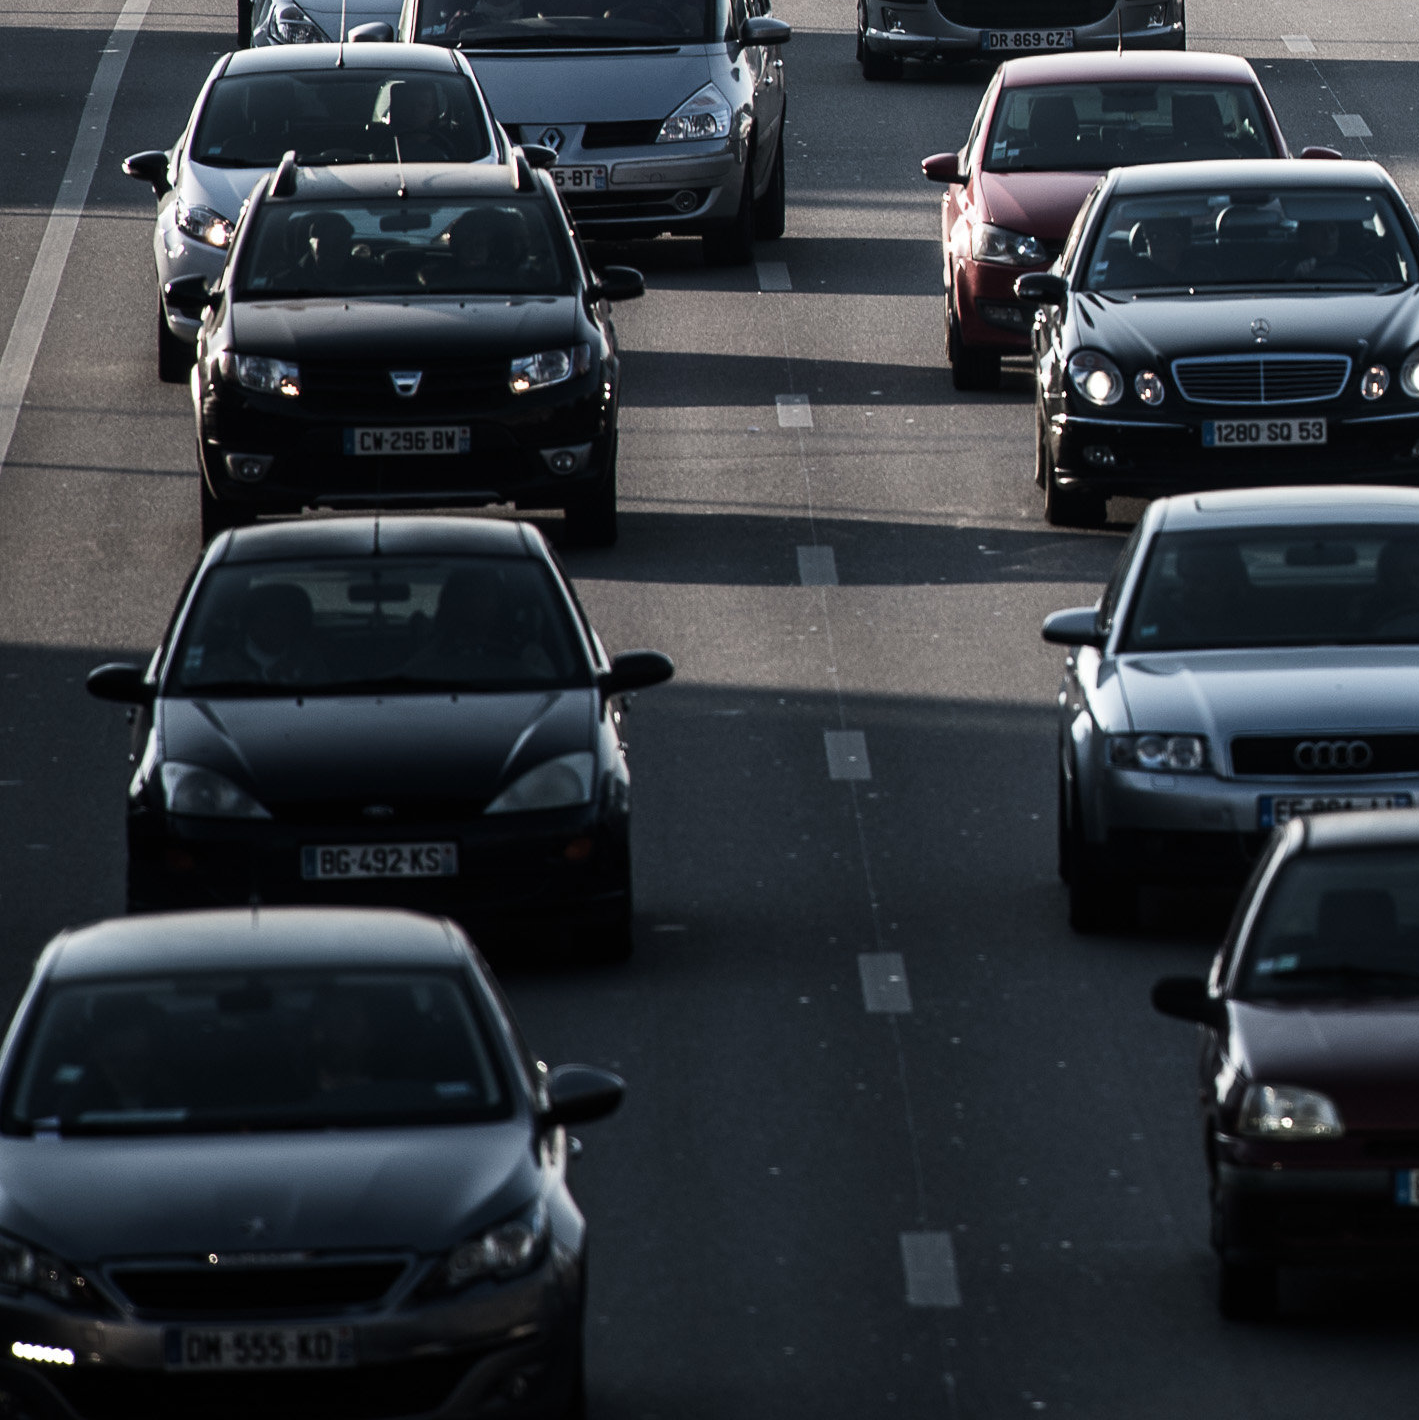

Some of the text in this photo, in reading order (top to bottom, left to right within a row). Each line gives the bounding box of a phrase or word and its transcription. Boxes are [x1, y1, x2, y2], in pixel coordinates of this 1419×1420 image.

[989, 32, 1065, 49] DR-869-GZ
[1216, 423, 1260, 443] 1280
[1298, 421, 1324, 441] 53
[320, 847, 441, 875] BG-492-KS
